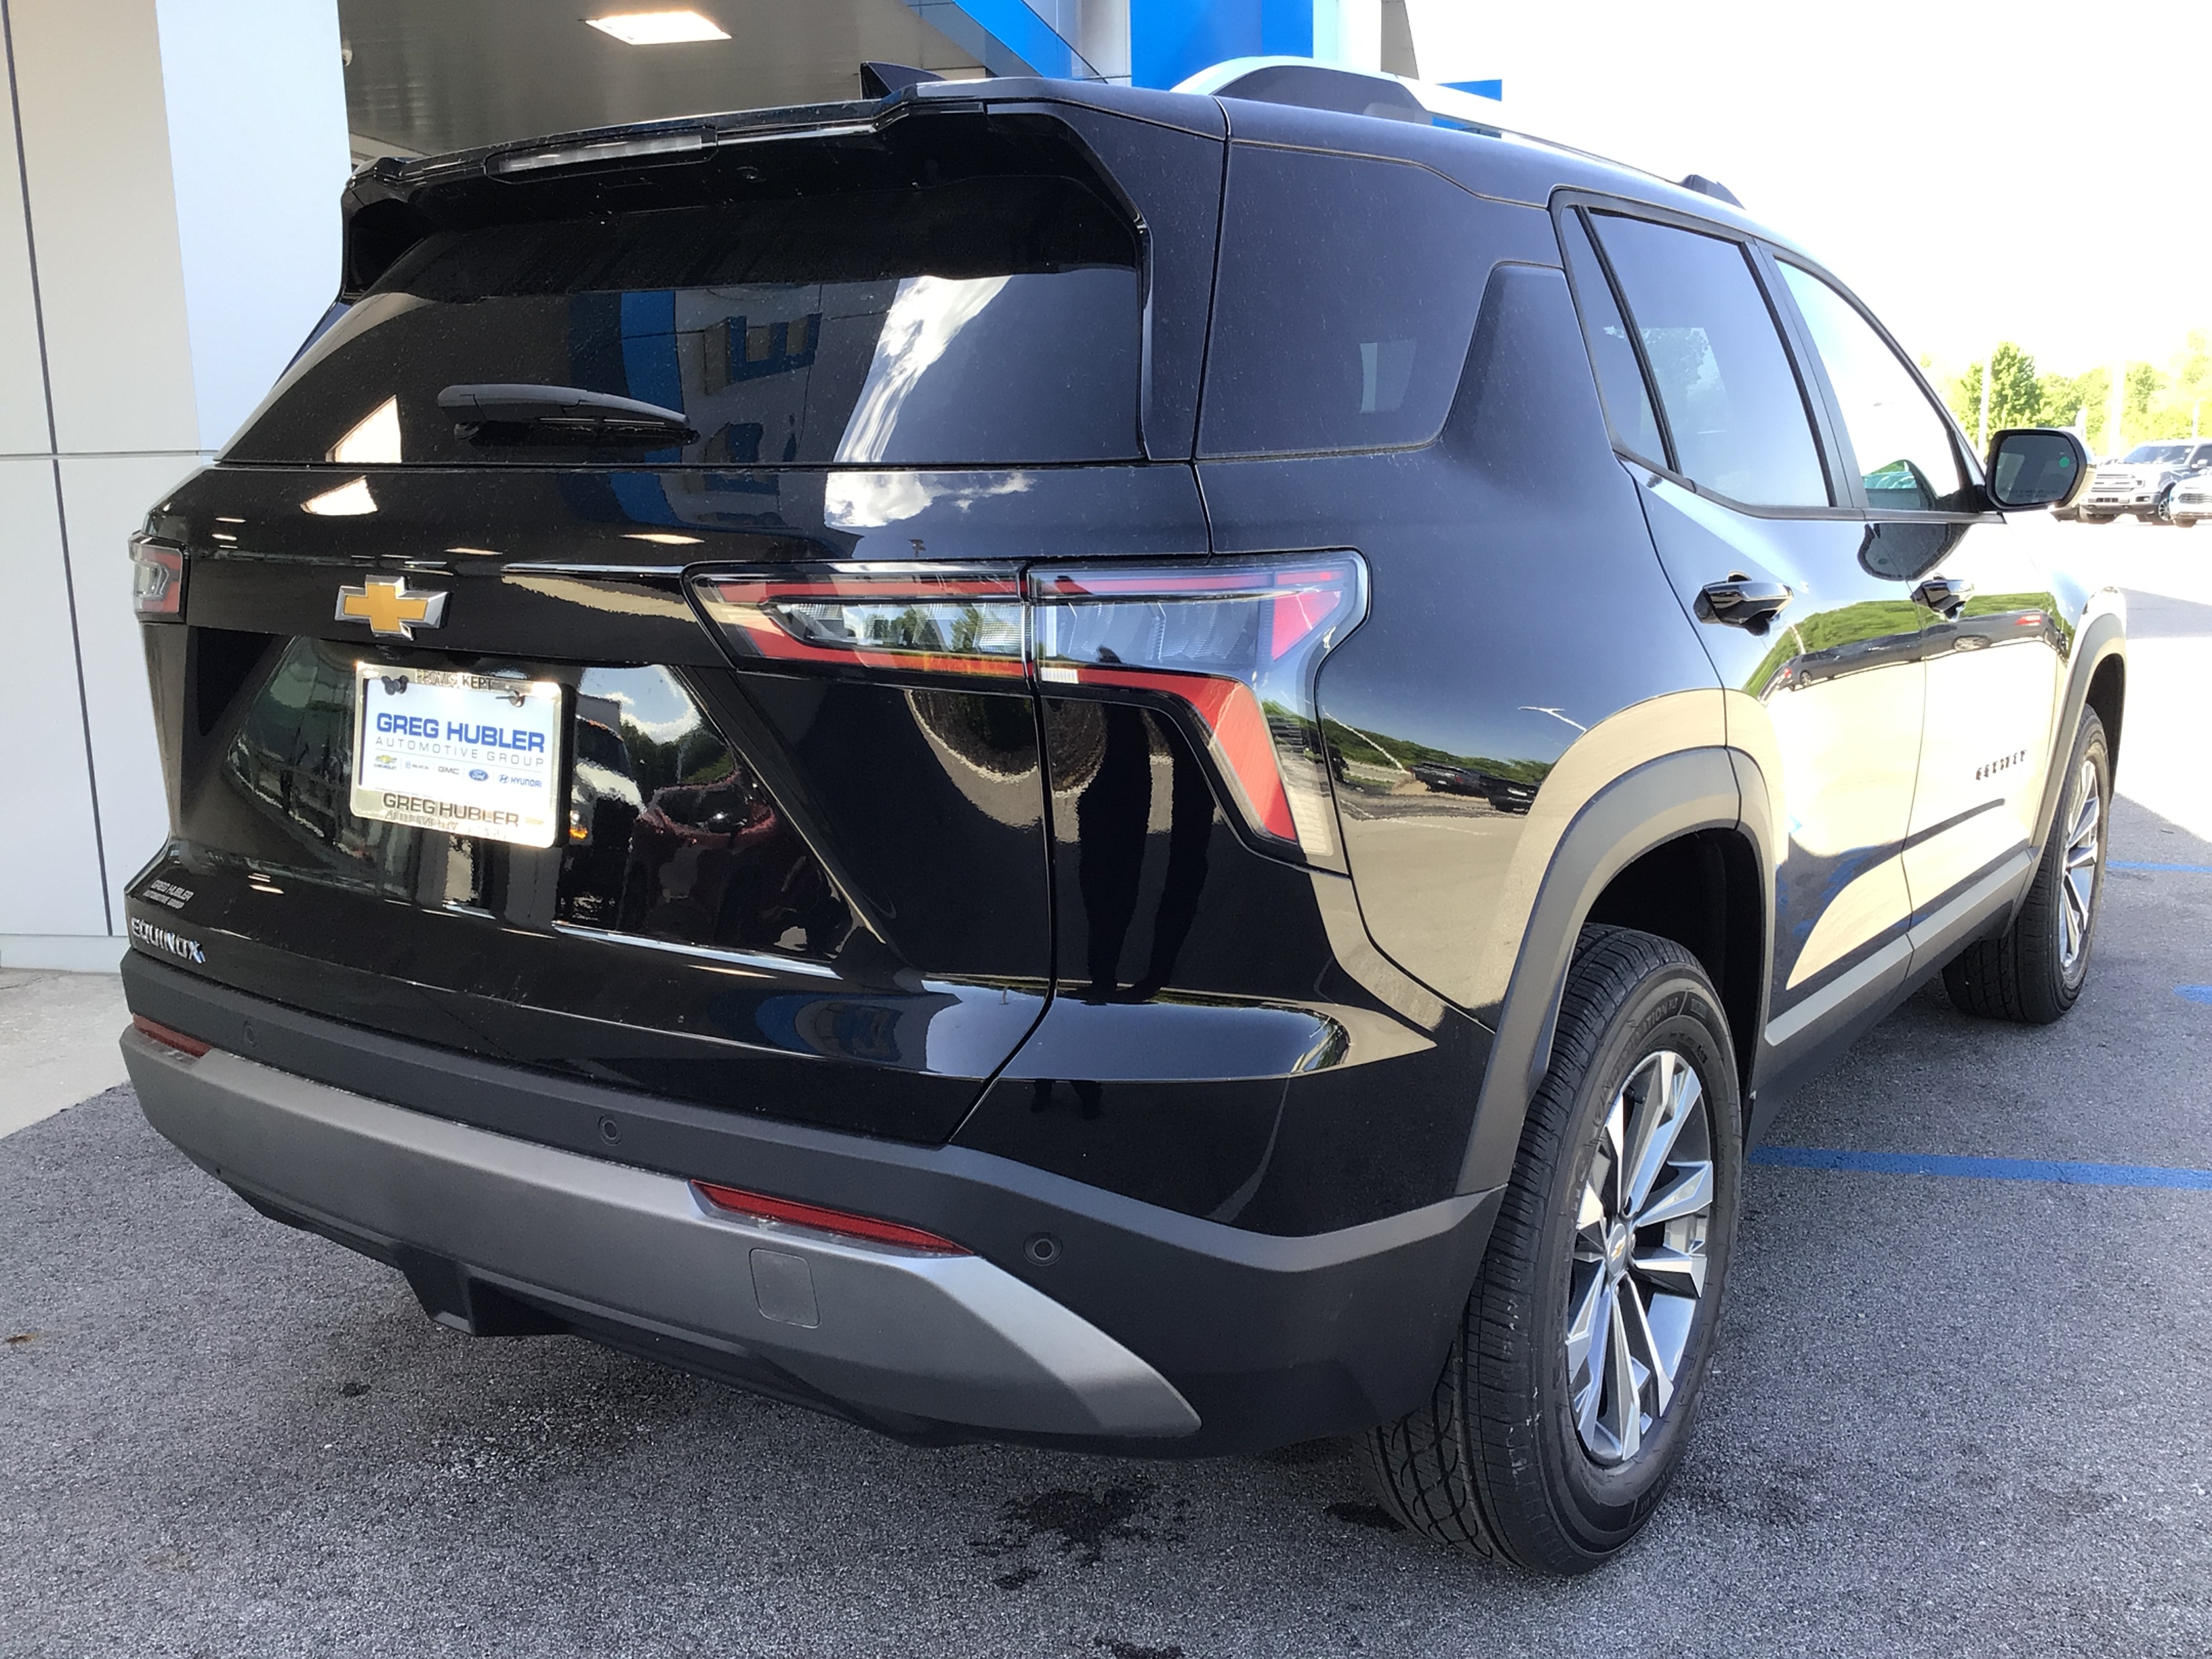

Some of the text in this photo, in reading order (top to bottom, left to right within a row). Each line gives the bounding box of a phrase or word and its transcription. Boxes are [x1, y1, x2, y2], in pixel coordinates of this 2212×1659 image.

[462, 674, 493, 691] KEPT
[376, 712, 545, 753] GREG HUBLER
[375, 736, 544, 768] AUTOMOTIVE GROUP
[438, 766, 459, 775] GMC
[510, 777, 542, 787] HYUNDAI
[383, 792, 436, 813] GREG
[439, 801, 519, 827] HUBLER
[131, 917, 204, 964] EQUINOX
